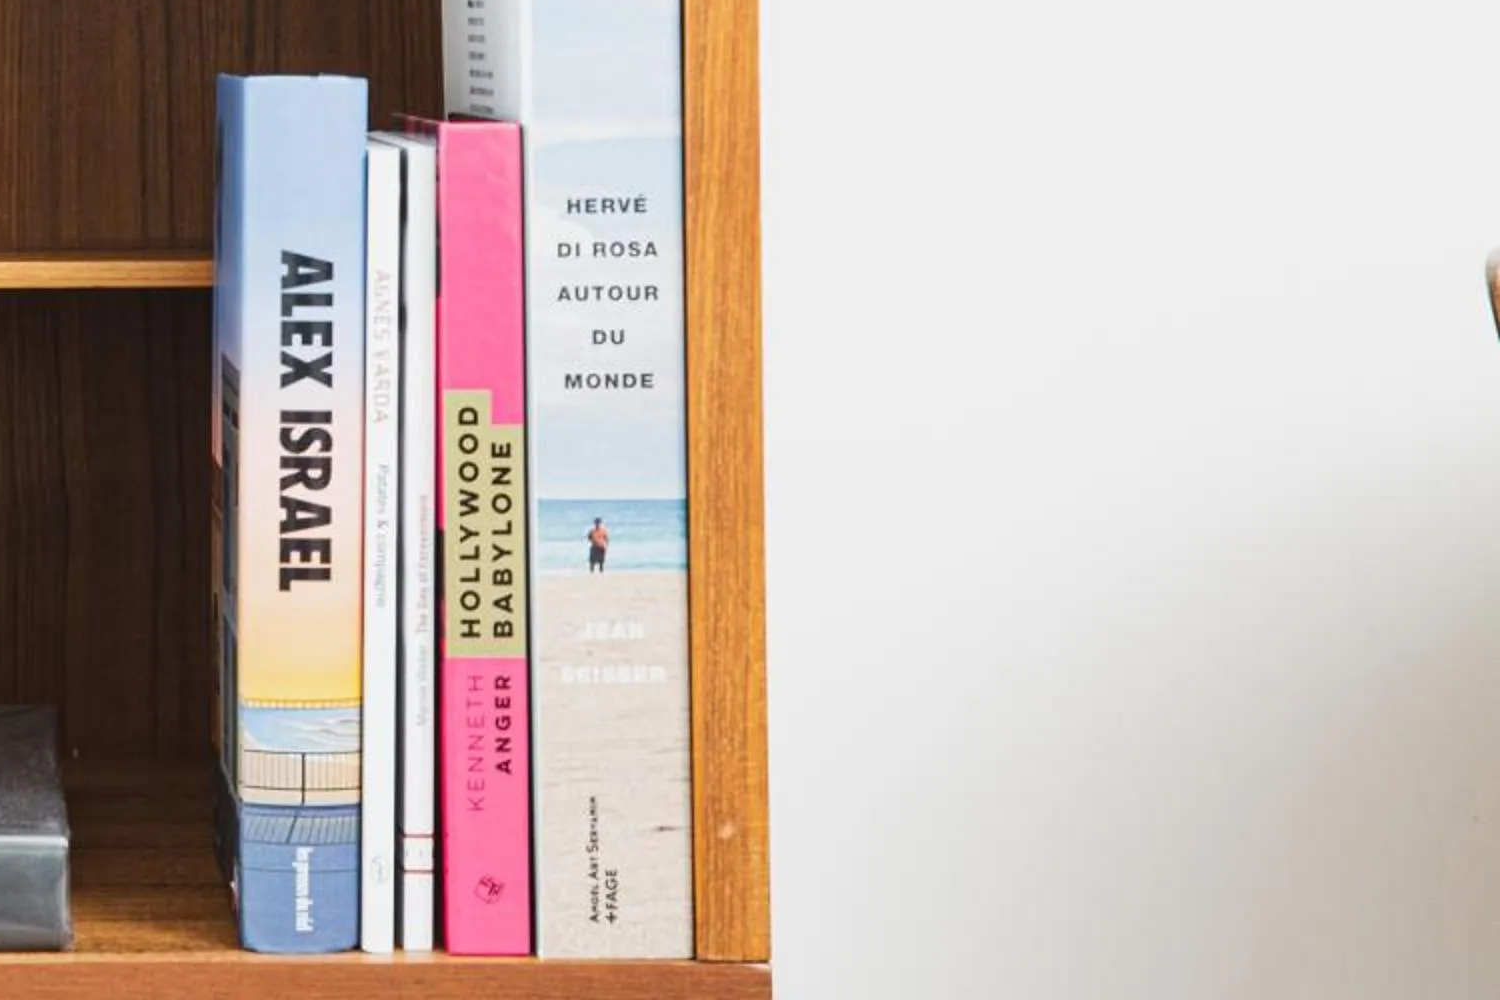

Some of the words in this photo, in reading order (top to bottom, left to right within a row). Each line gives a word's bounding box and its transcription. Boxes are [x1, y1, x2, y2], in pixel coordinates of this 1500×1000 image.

[566, 194, 648, 214] HERVÉ
[556, 241, 581, 258] DI
[592, 241, 659, 258] ROSA
[279, 248, 334, 389] ALEX
[556, 285, 660, 302] AUTOUR
[592, 329, 625, 346] DU
[373, 348, 390, 424] VARDA
[564, 373, 655, 390] MONDE
[278, 409, 334, 593] ISRAEL
[458, 406, 481, 639] HOLLYWOOD
[490, 442, 514, 639] BABYLONE
[582, 619, 645, 640] JEAN
[466, 674, 485, 812] KENNETH
[494, 675, 513, 776] ANGER
